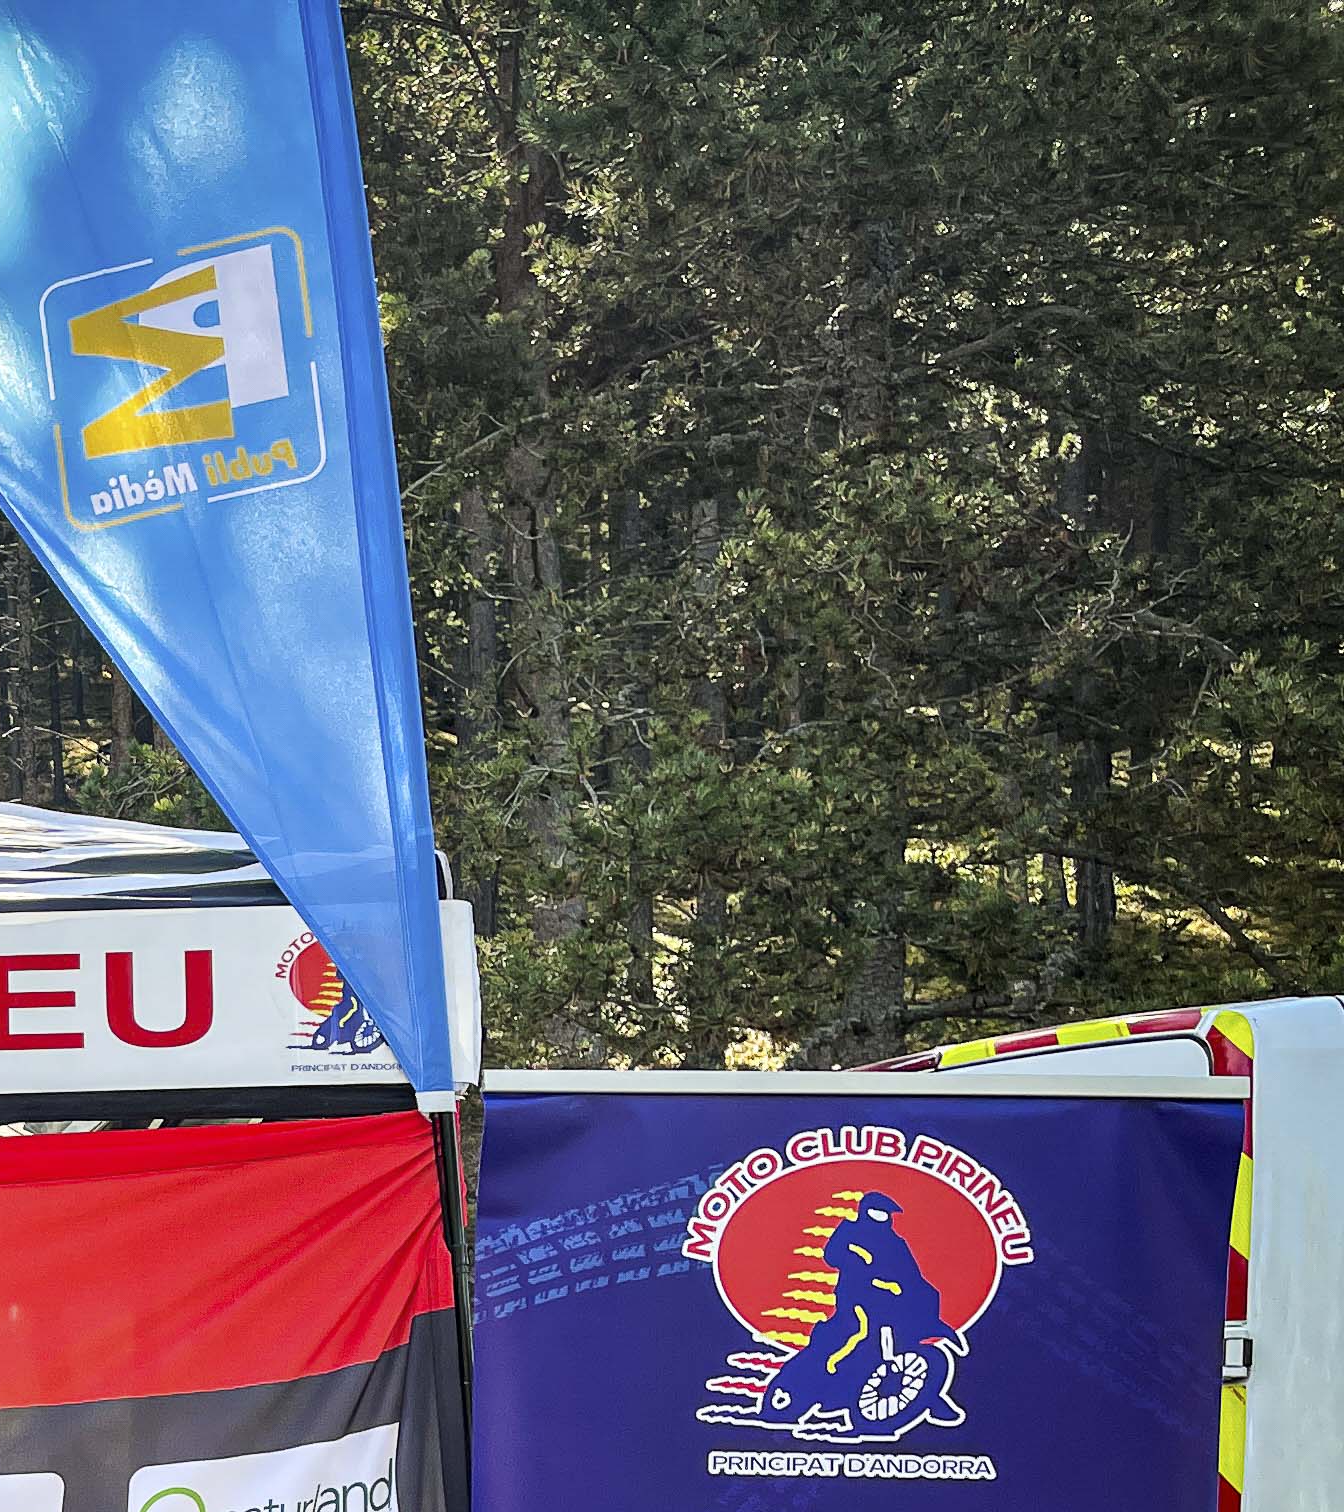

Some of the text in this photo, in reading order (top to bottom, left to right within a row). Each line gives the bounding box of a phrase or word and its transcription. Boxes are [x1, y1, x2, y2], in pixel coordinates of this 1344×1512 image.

[275, 931, 315, 979] MOTO
[291, 1063, 347, 1072] PRINCIPAT
[684, 1130, 1032, 1263] MOTO CLUB PIRINEU
[711, 1453, 994, 1478] PRINCIPAT D'ANDORRA
